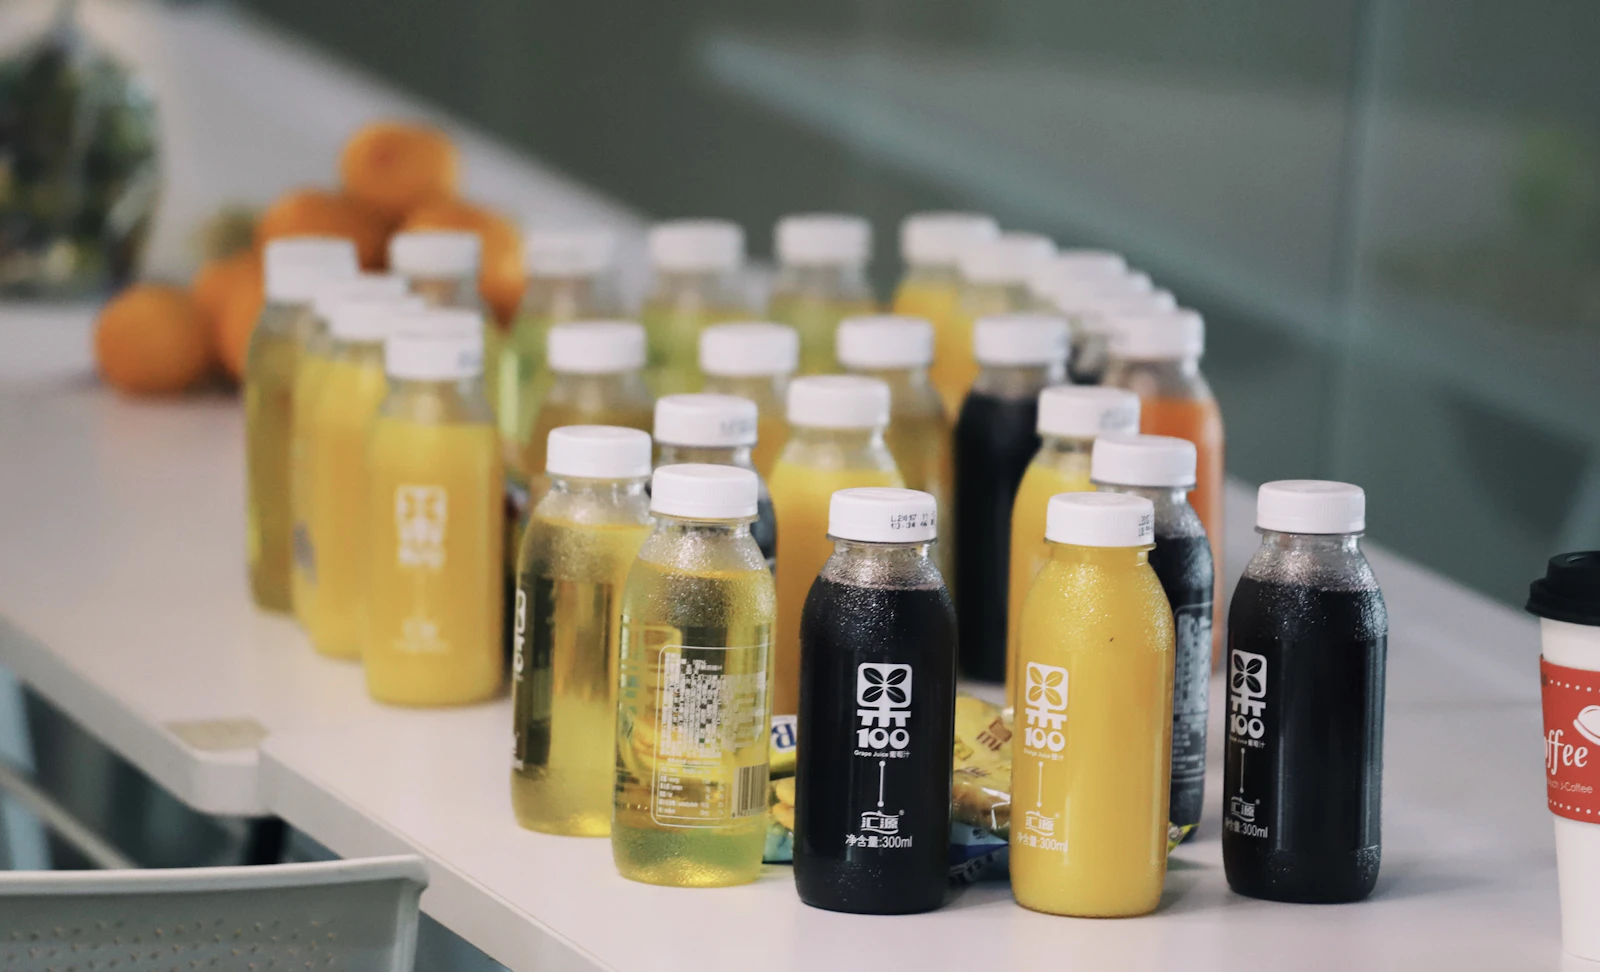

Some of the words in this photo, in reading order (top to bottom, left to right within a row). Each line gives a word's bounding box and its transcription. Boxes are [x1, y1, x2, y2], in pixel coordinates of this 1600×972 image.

[856, 727, 910, 750] 100
[1230, 714, 1265, 739] 100
[1024, 727, 1066, 752] 100
[1544, 729, 1588, 776] ffee
[860, 815, 900, 831] 汇源
